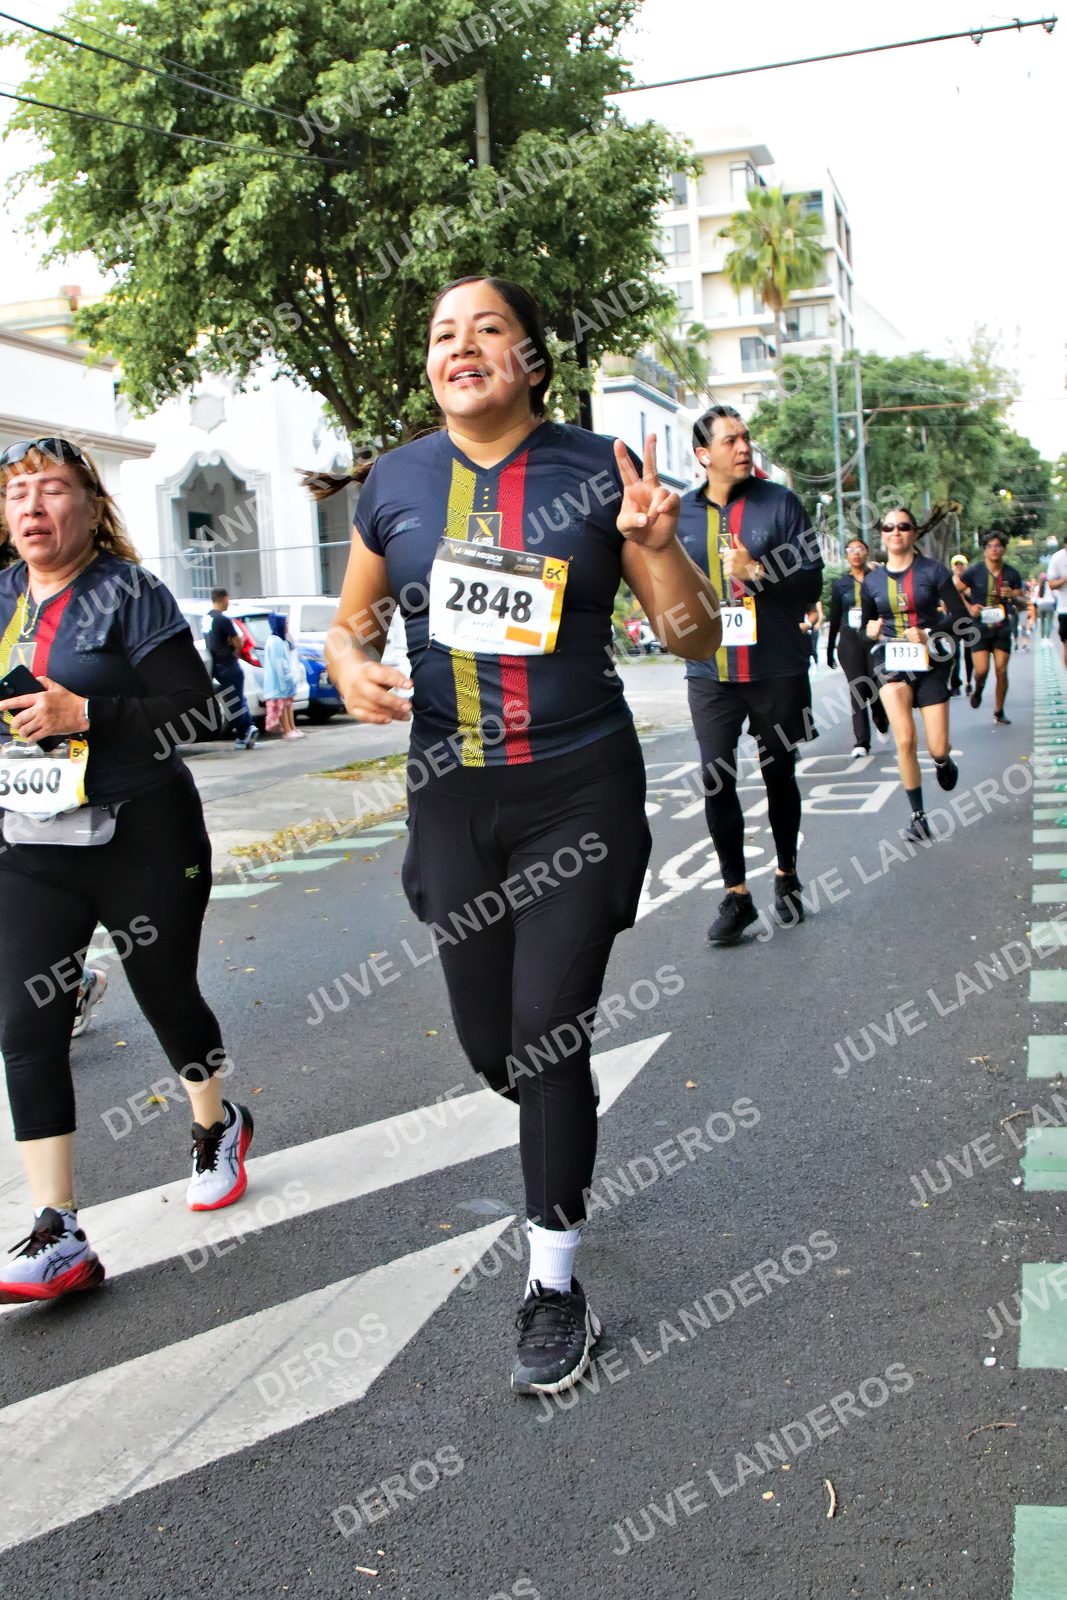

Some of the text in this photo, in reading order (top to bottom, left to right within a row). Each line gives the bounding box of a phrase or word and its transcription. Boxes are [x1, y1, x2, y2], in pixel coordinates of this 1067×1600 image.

[545, 568, 563, 581] 5K
[445, 577, 533, 624] 2848
[892, 646, 919, 658] 1313
[0, 767, 61, 796] 3600
